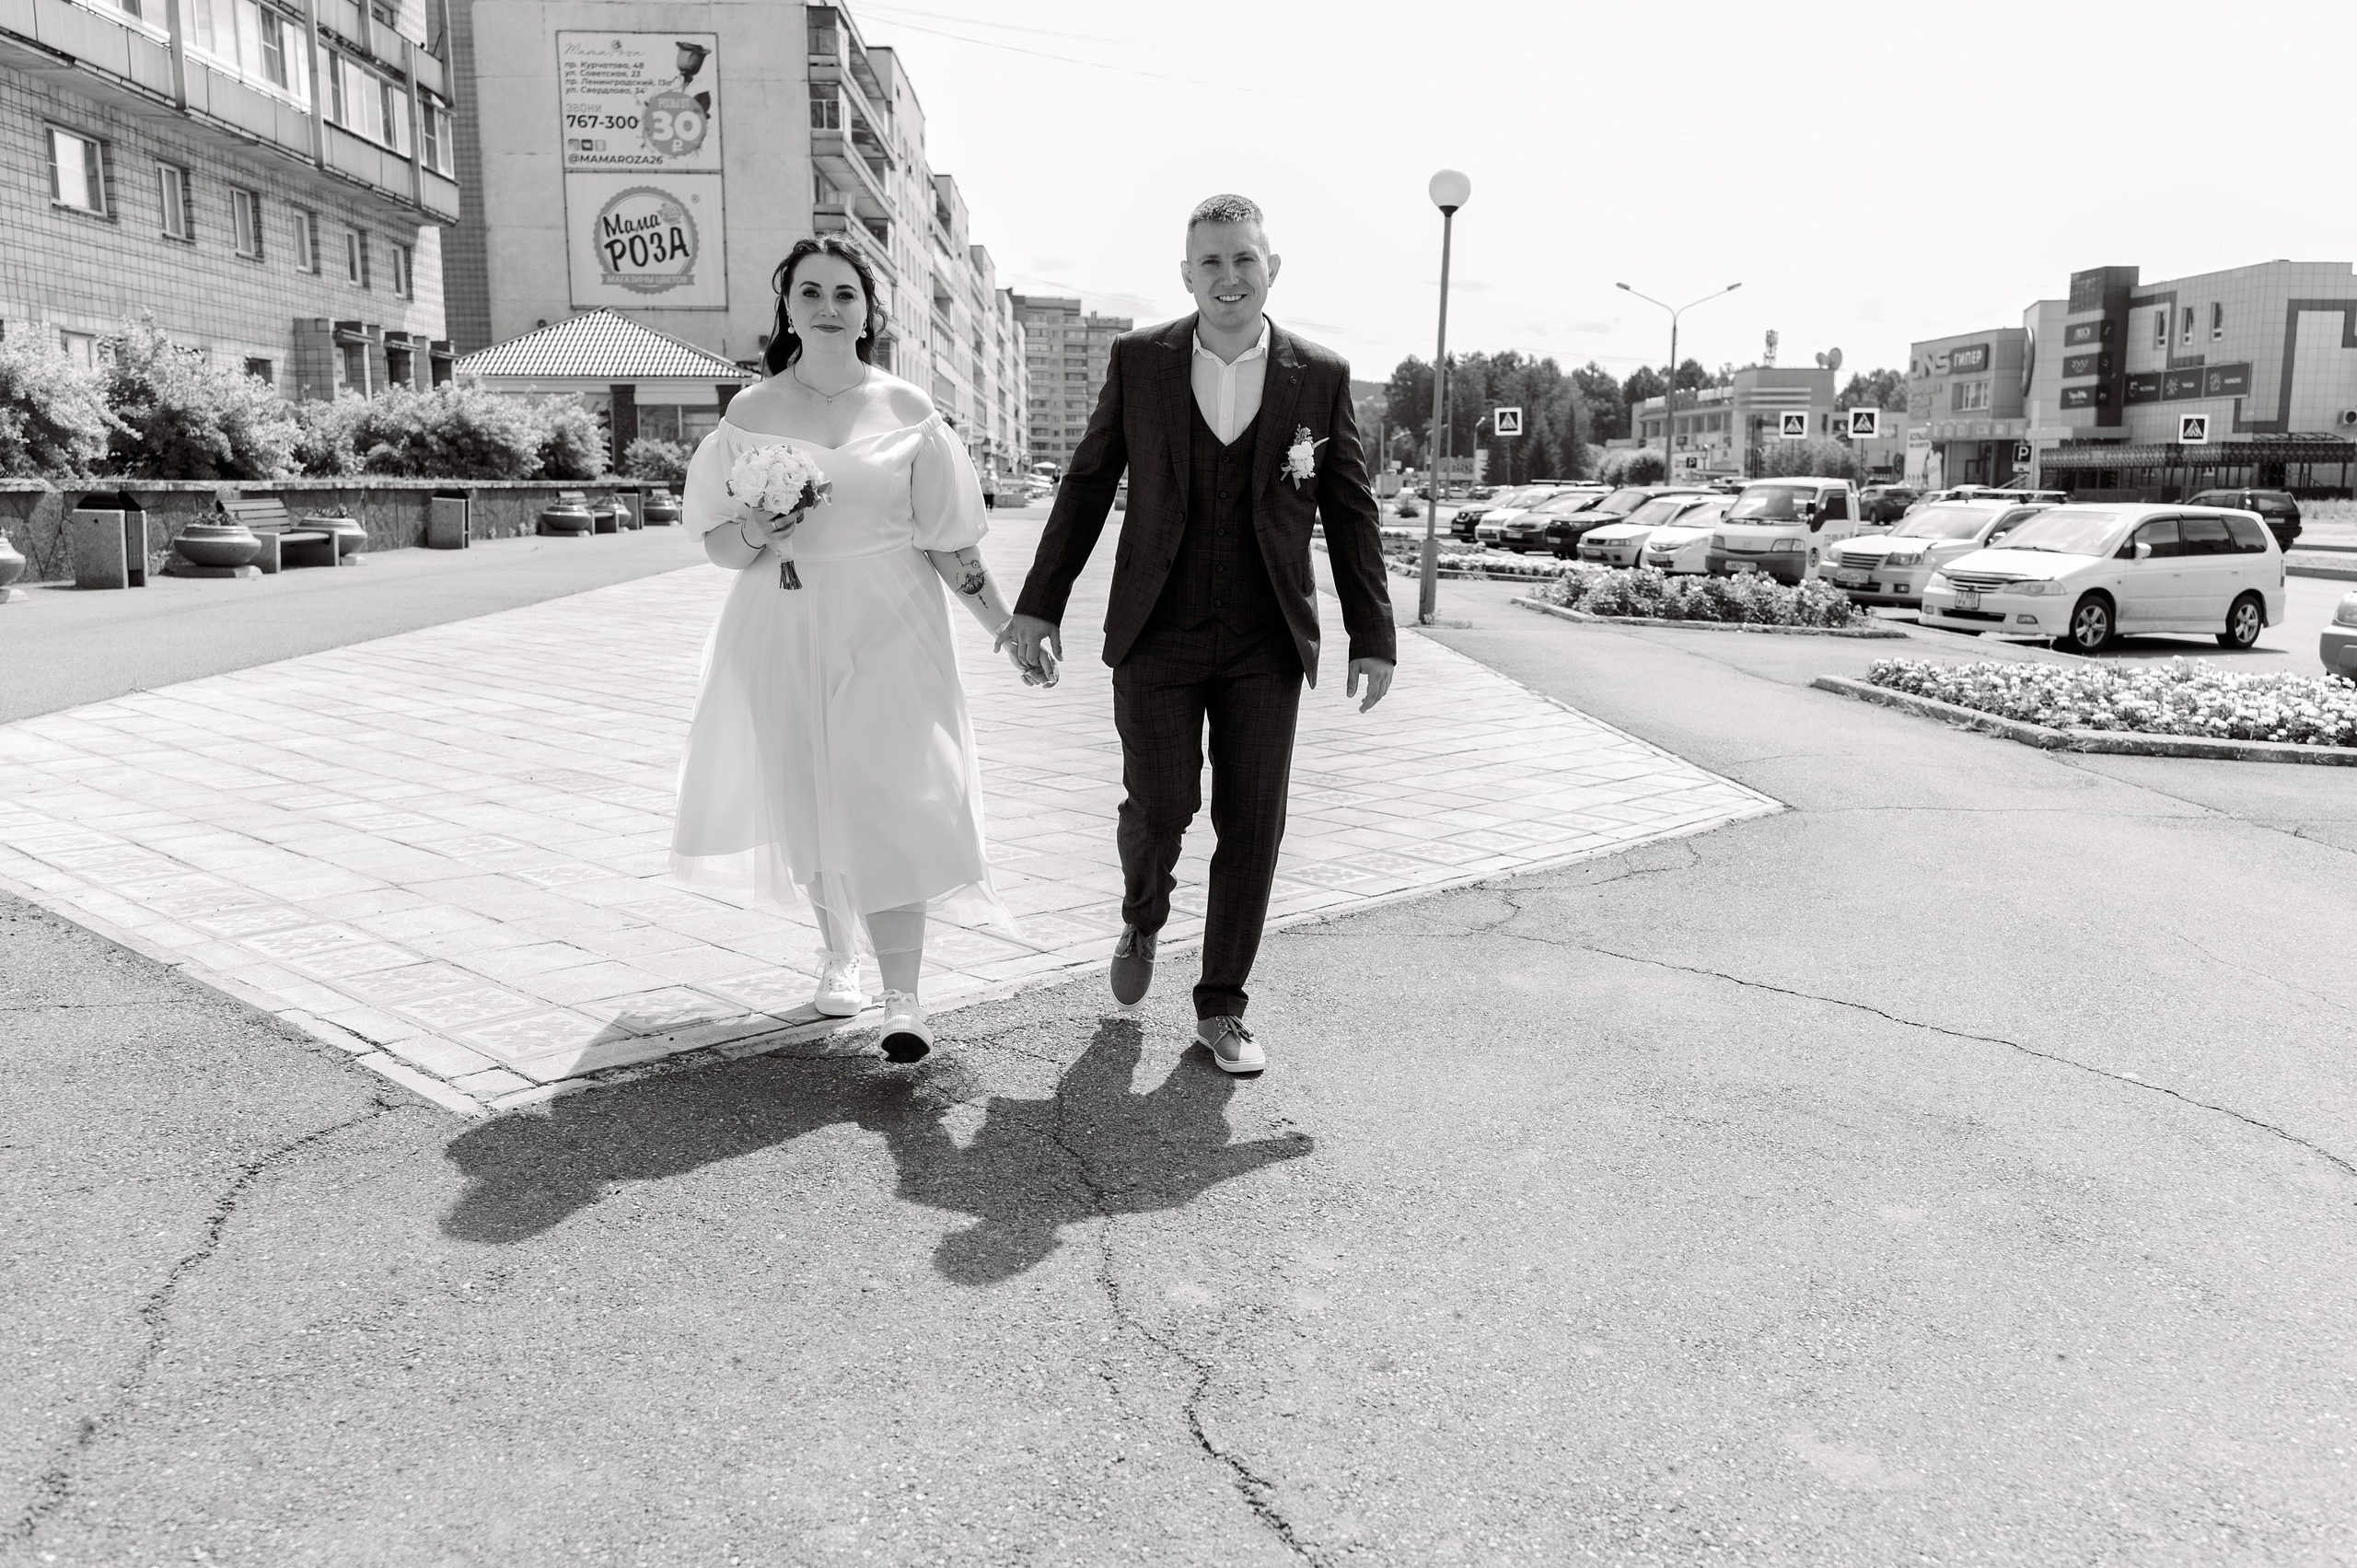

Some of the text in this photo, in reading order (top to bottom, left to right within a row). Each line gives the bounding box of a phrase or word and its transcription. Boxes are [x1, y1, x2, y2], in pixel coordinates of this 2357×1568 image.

[580, 61, 631, 70] Курчатова,
[580, 69, 629, 78] Советская,
[566, 103, 602, 113] ЗВОНИ
[566, 115, 638, 129] 767-300
[653, 110, 702, 141] 30
[568, 154, 663, 165] @MAMAROZA26
[603, 215, 660, 238] Мама
[604, 227, 690, 272] РОЗА
[1910, 349, 1951, 379] DNS
[1954, 349, 1983, 368] ГИПЕР
[2018, 446, 2029, 461] P
